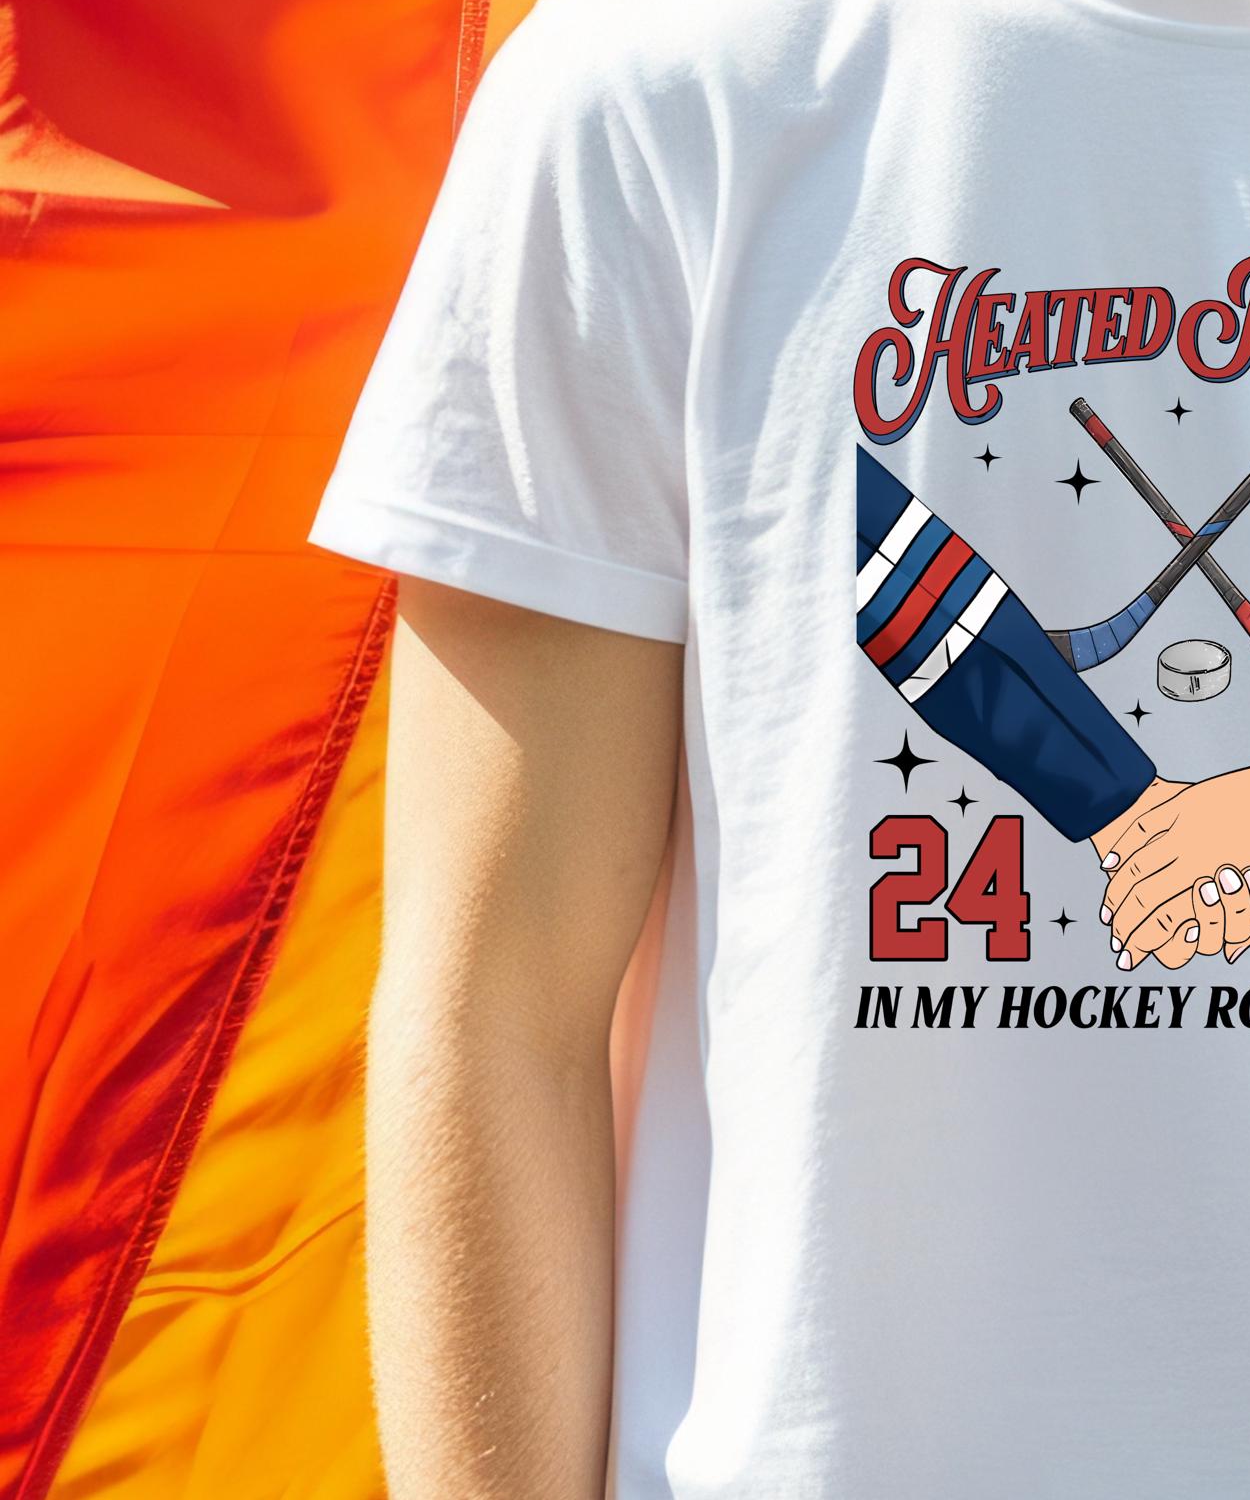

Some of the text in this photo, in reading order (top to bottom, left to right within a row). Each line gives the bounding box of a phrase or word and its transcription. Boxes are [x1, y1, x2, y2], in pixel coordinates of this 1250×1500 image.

[854, 257, 1176, 445] HEATED
[869, 815, 1031, 961] 24
[854, 986, 902, 1029] IN
[910, 986, 989, 1029] MY
[996, 986, 1199, 1029] HOCKEY
